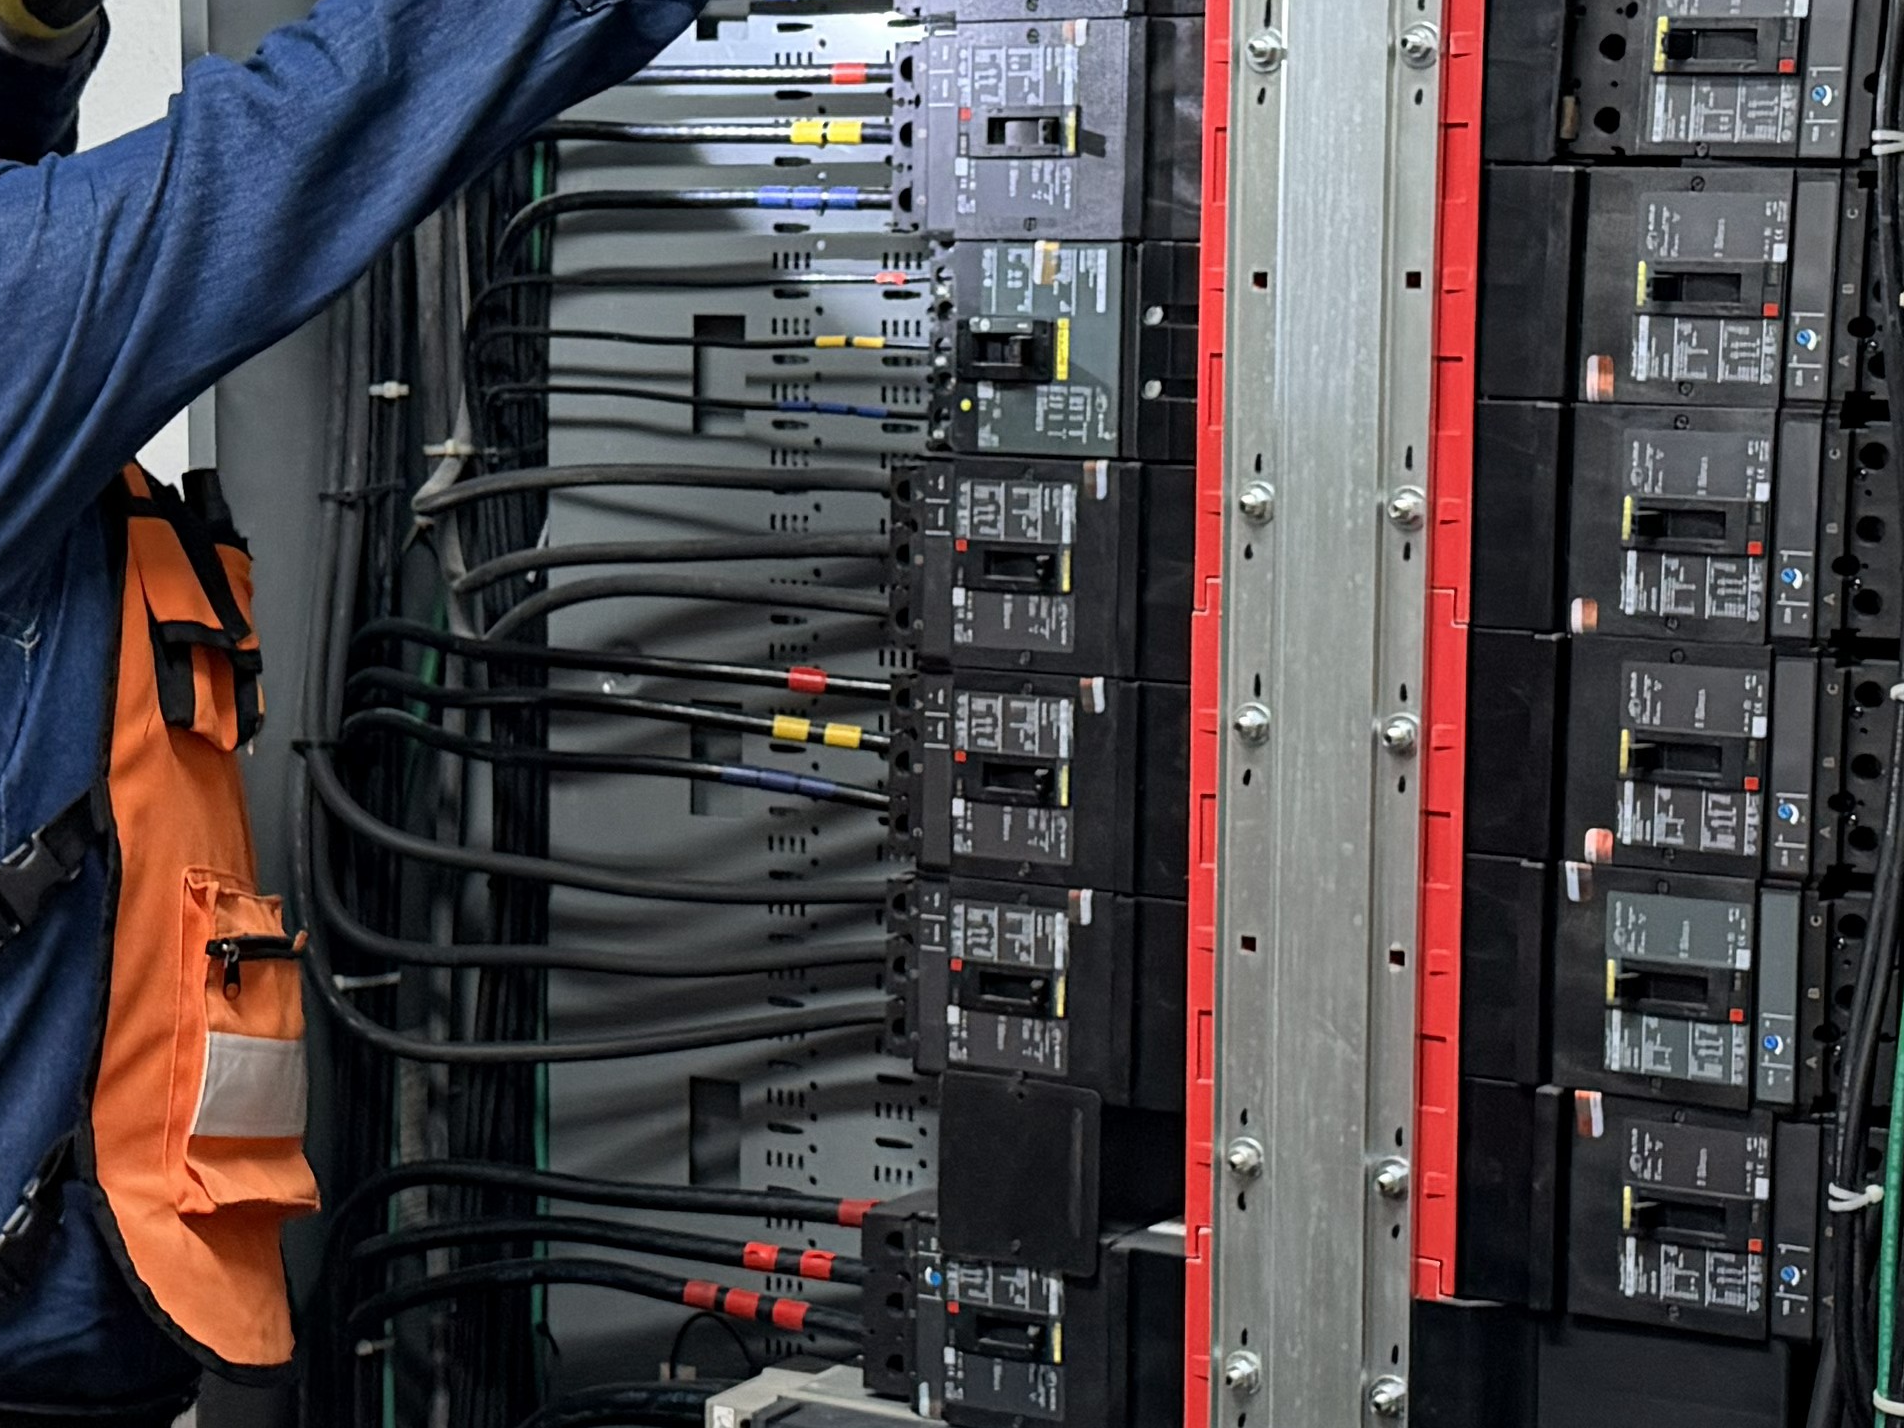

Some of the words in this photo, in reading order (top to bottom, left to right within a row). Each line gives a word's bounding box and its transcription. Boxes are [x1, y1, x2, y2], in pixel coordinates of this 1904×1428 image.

[1838, 355, 1849, 367] A
[1823, 593, 1835, 605] A
[1819, 827, 1831, 838] A
[1806, 1057, 1817, 1068] A
